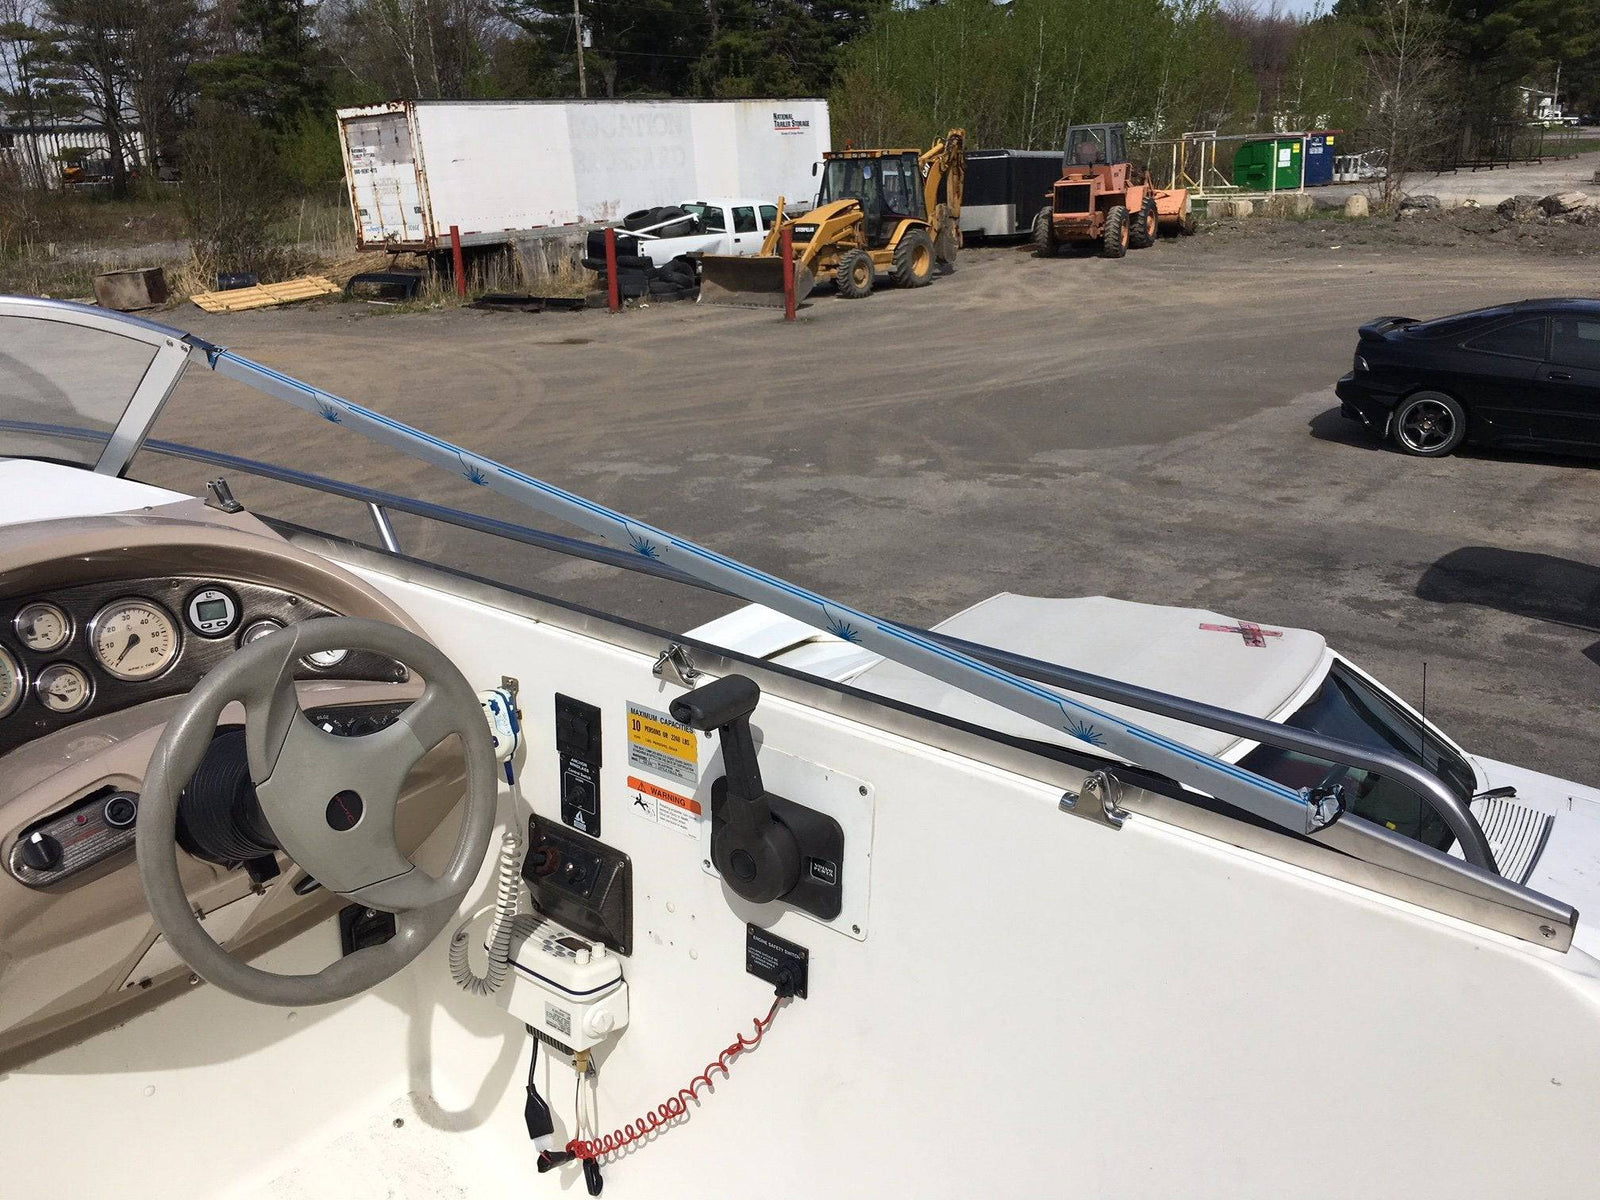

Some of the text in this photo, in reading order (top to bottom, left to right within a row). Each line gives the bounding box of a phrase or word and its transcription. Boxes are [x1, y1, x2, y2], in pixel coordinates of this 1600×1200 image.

[630, 707, 694, 734] MAXIMUM CAPACITIES
[632, 719, 641, 732] 10
[644, 725, 661, 736] PERSONS
[650, 786, 686, 806] WARNING
[752, 935, 768, 946] ENGINE
[768, 942, 784, 953] SAFETY
[784, 948, 801, 960] SWITCH
